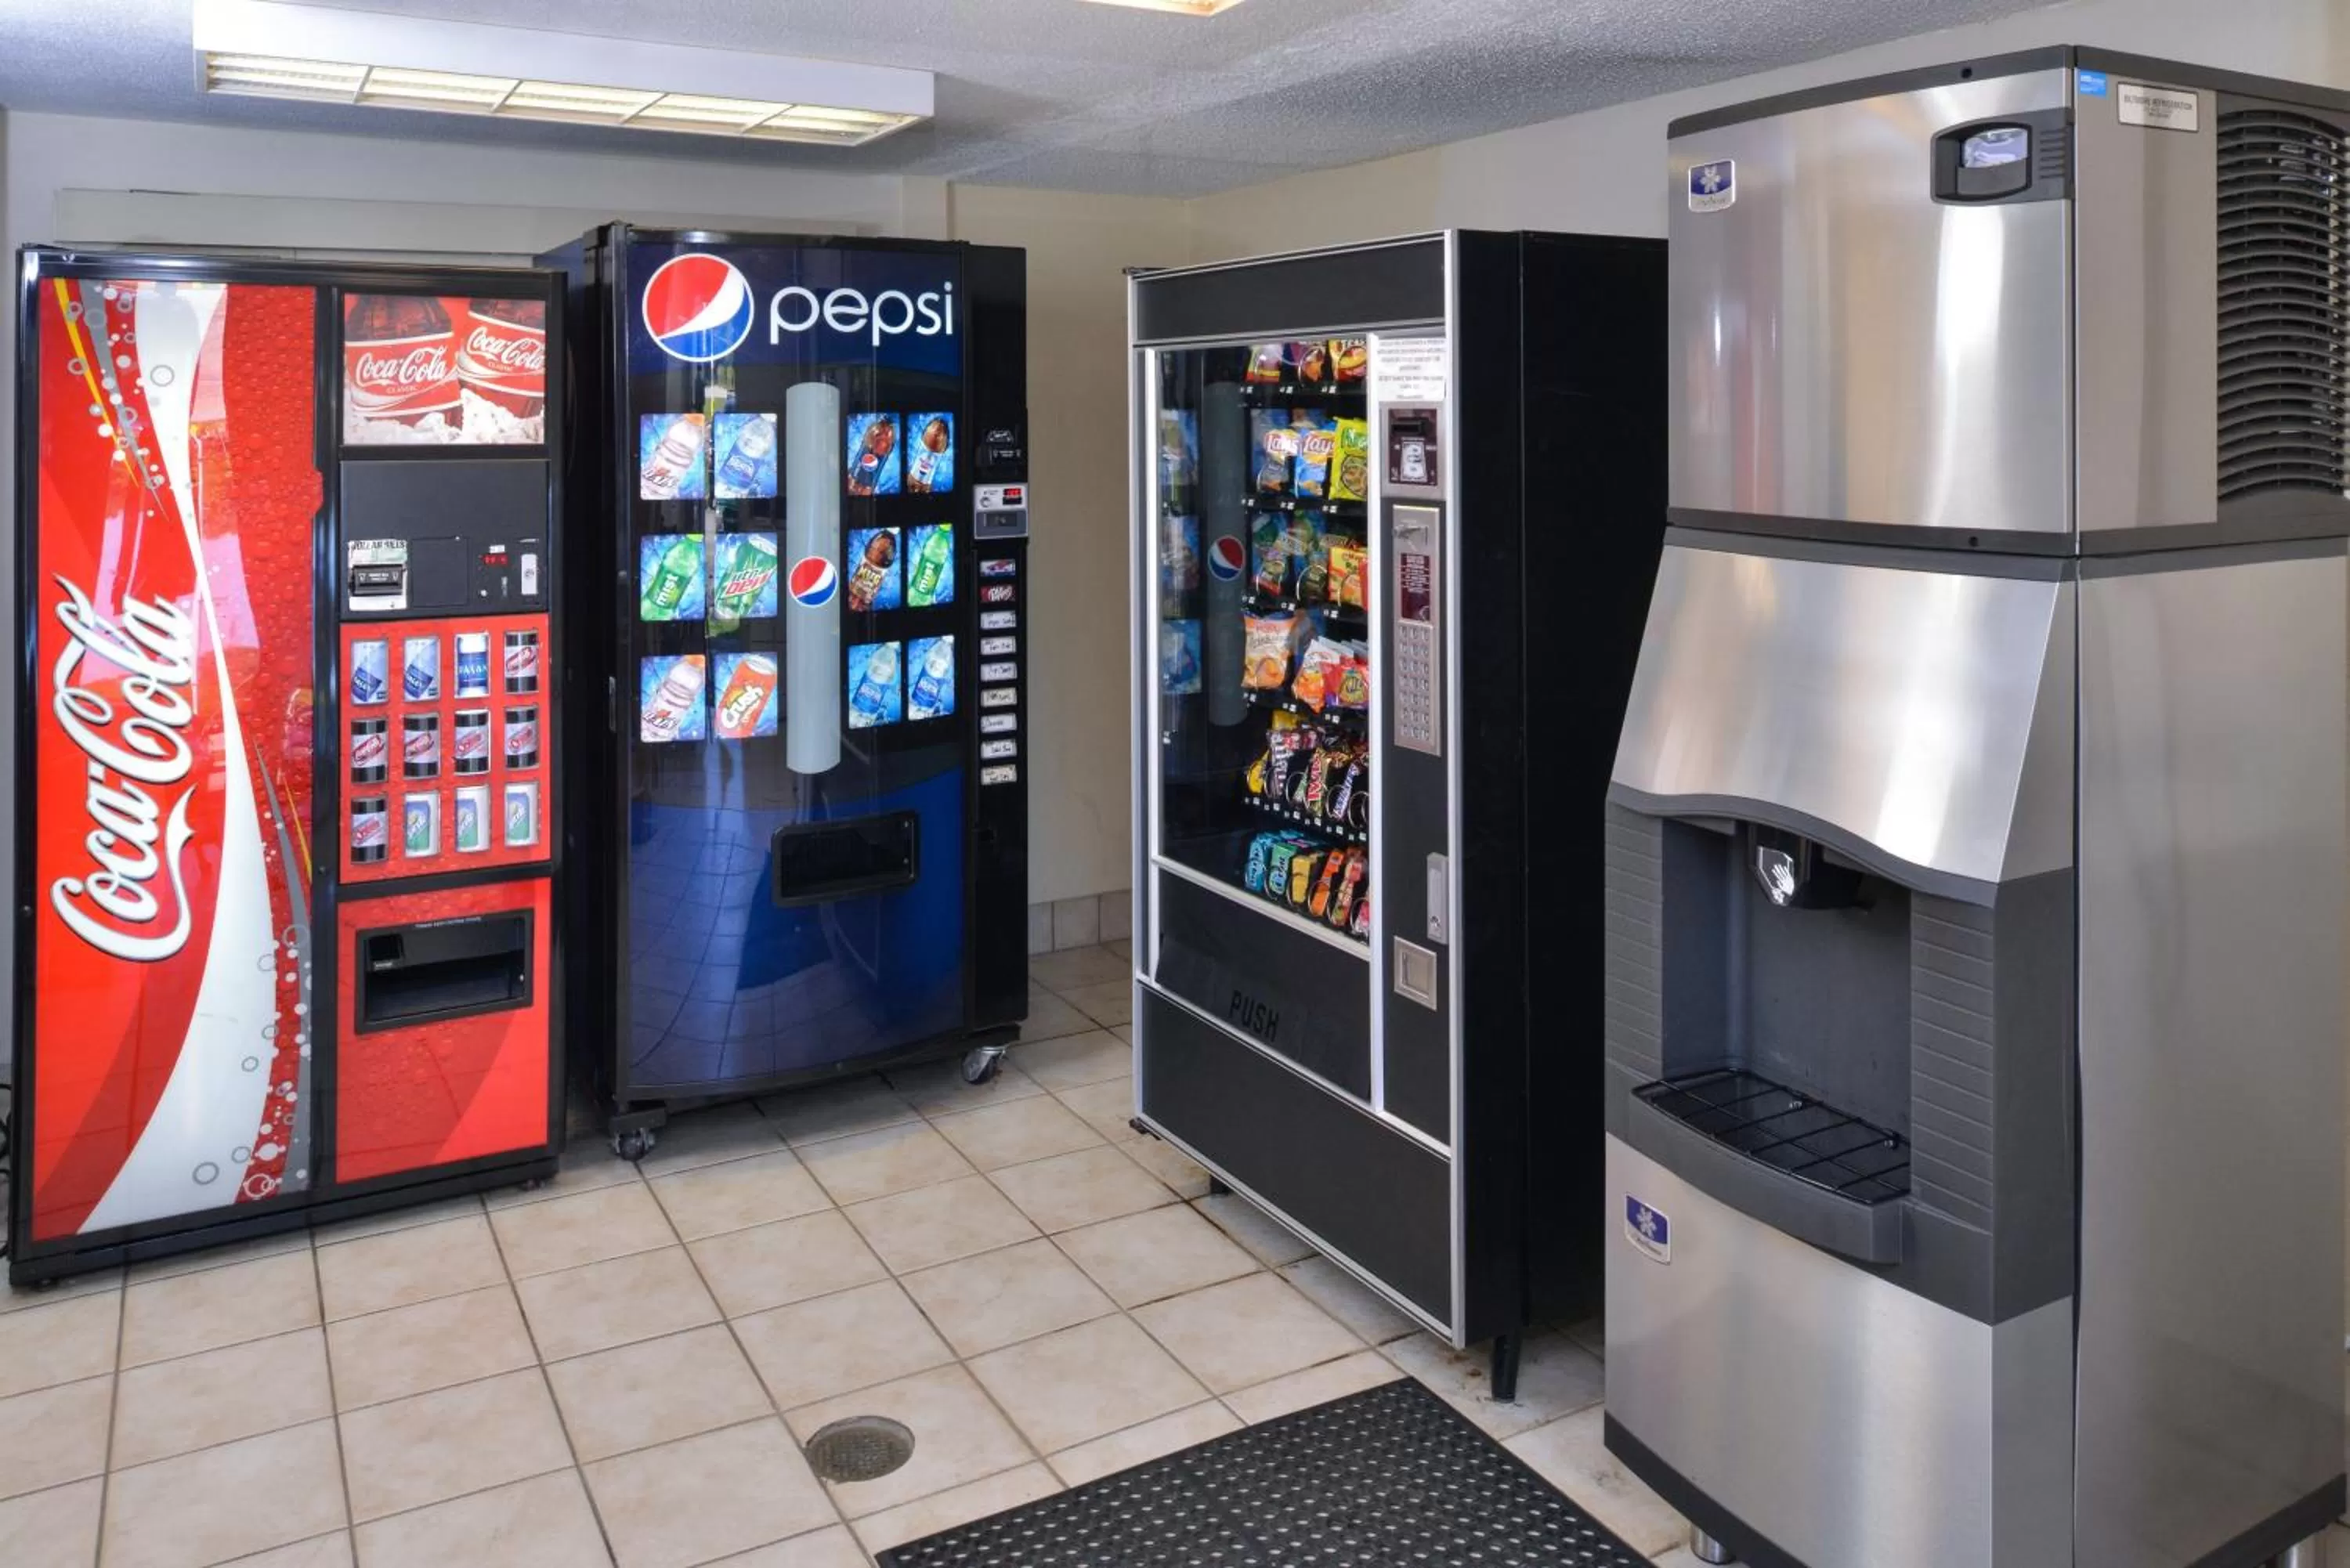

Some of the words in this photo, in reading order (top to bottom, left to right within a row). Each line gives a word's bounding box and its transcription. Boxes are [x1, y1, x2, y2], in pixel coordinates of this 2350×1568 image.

[770, 281, 953, 347] pepsi
[356, 345, 448, 388] Coca-Cola
[466, 326, 544, 370] Coca-Cola
[50, 573, 197, 962] Coca-Cola
[1227, 989, 1280, 1043] PUSH
